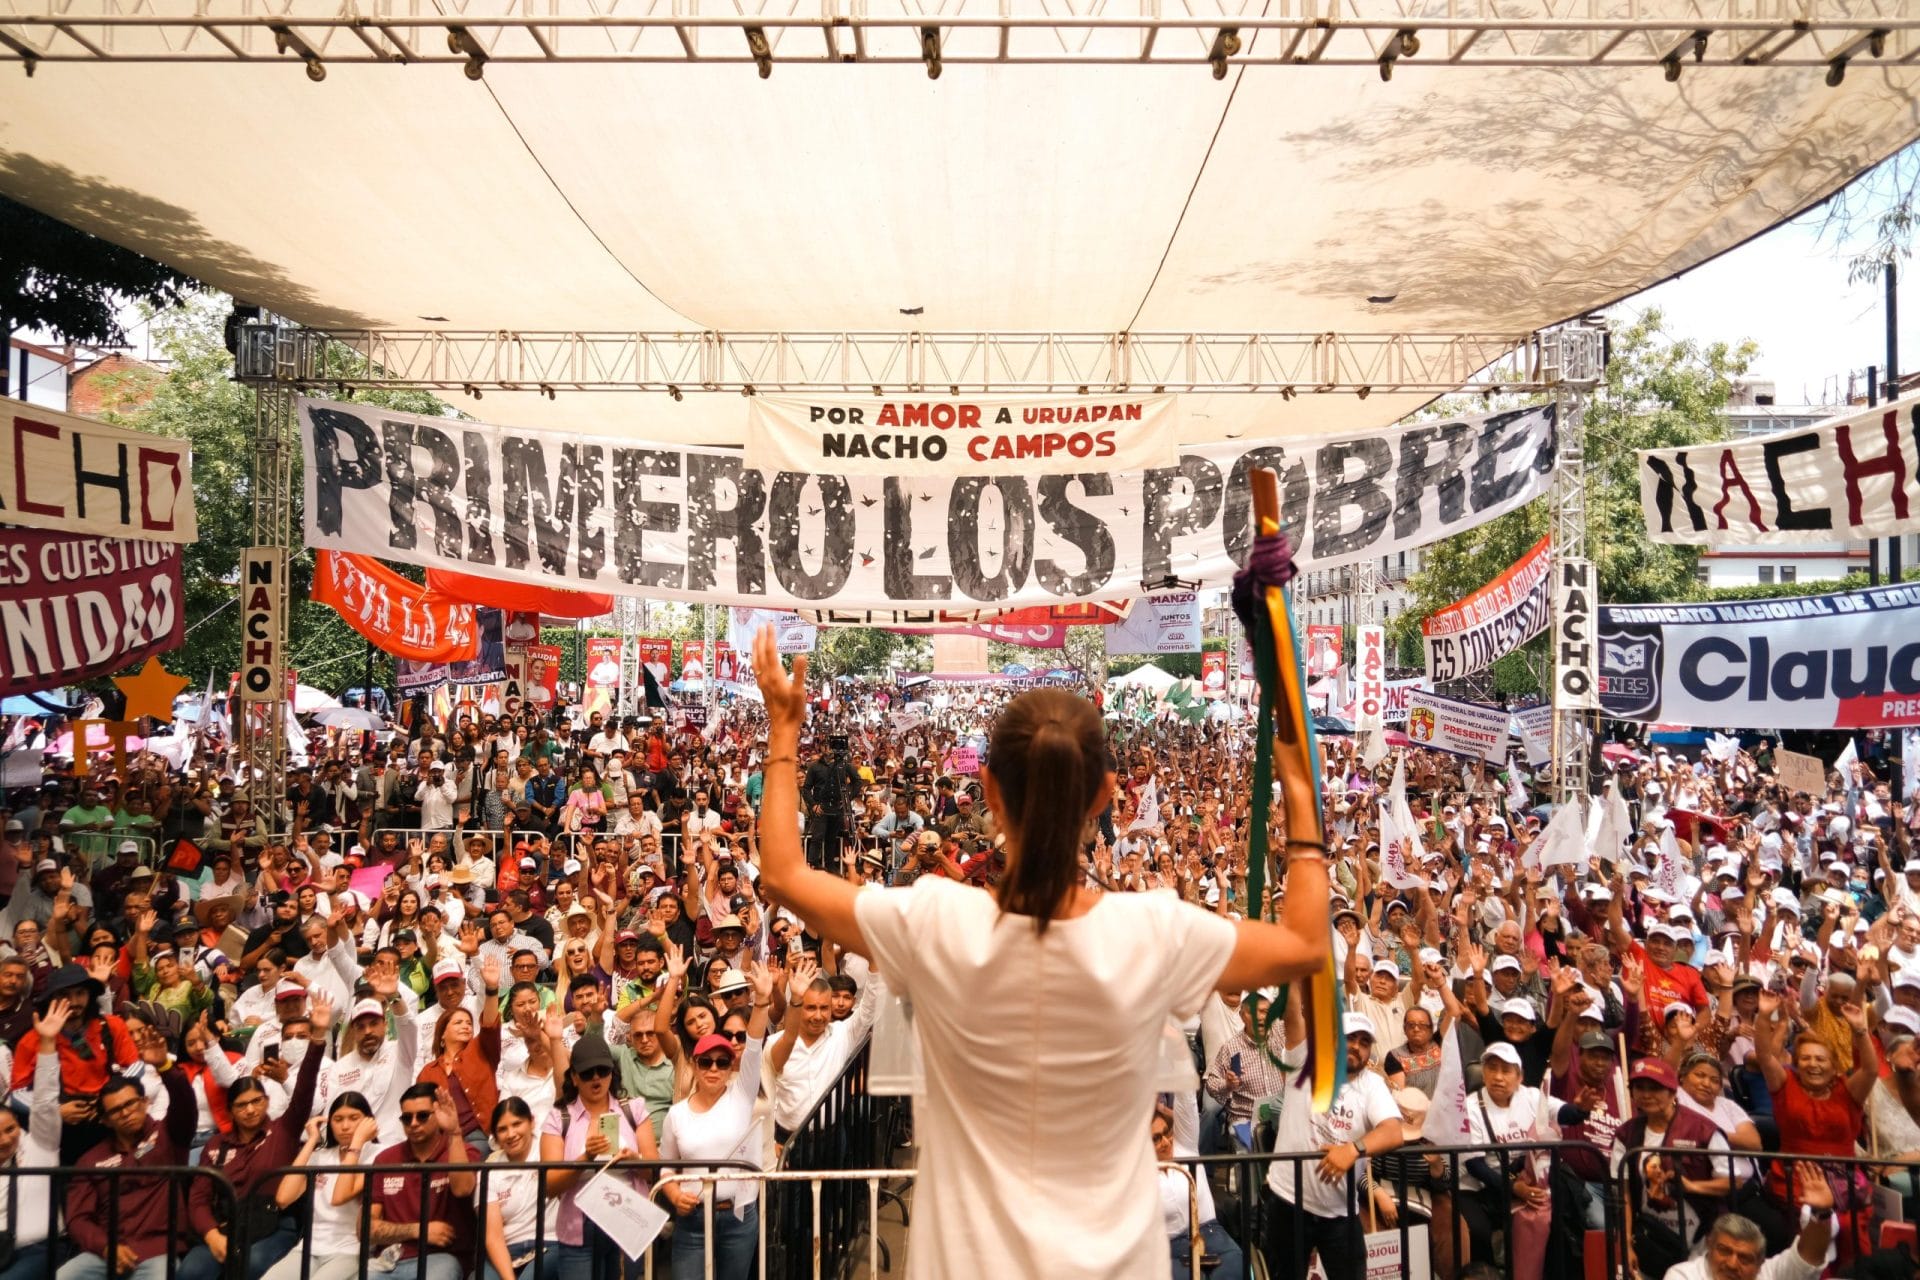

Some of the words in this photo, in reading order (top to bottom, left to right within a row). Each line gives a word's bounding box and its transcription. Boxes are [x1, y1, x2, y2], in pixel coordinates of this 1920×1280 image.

[810, 406, 864, 424] POR
[876, 403, 982, 430] AMOR
[995, 407, 1012, 424] A
[1022, 404, 1142, 424] URUAPAN
[822, 433, 948, 461] NACHO
[967, 431, 1116, 461] CAMPOS
[0, 416, 181, 531] CHO
[1647, 404, 1920, 532] NACH
[308, 405, 856, 600] PRIMERO
[883, 472, 1115, 602] LOS
[1609, 607, 1717, 623] SINDICATO
[1716, 599, 1834, 623] NACIONAL
[1833, 592, 1871, 612] DE
[246, 561, 272, 692] NACHO
[1562, 563, 1590, 695] NACHO
[527, 650, 558, 662] LAUDIA
[1362, 631, 1381, 716] NACHO
[1431, 639, 1456, 682] ES
[1441, 704, 1467, 715] GENERAL
[1476, 712, 1506, 724] URUAPAN
[1443, 724, 1497, 743] PRESENTE
[1368, 1245, 1399, 1258] more
